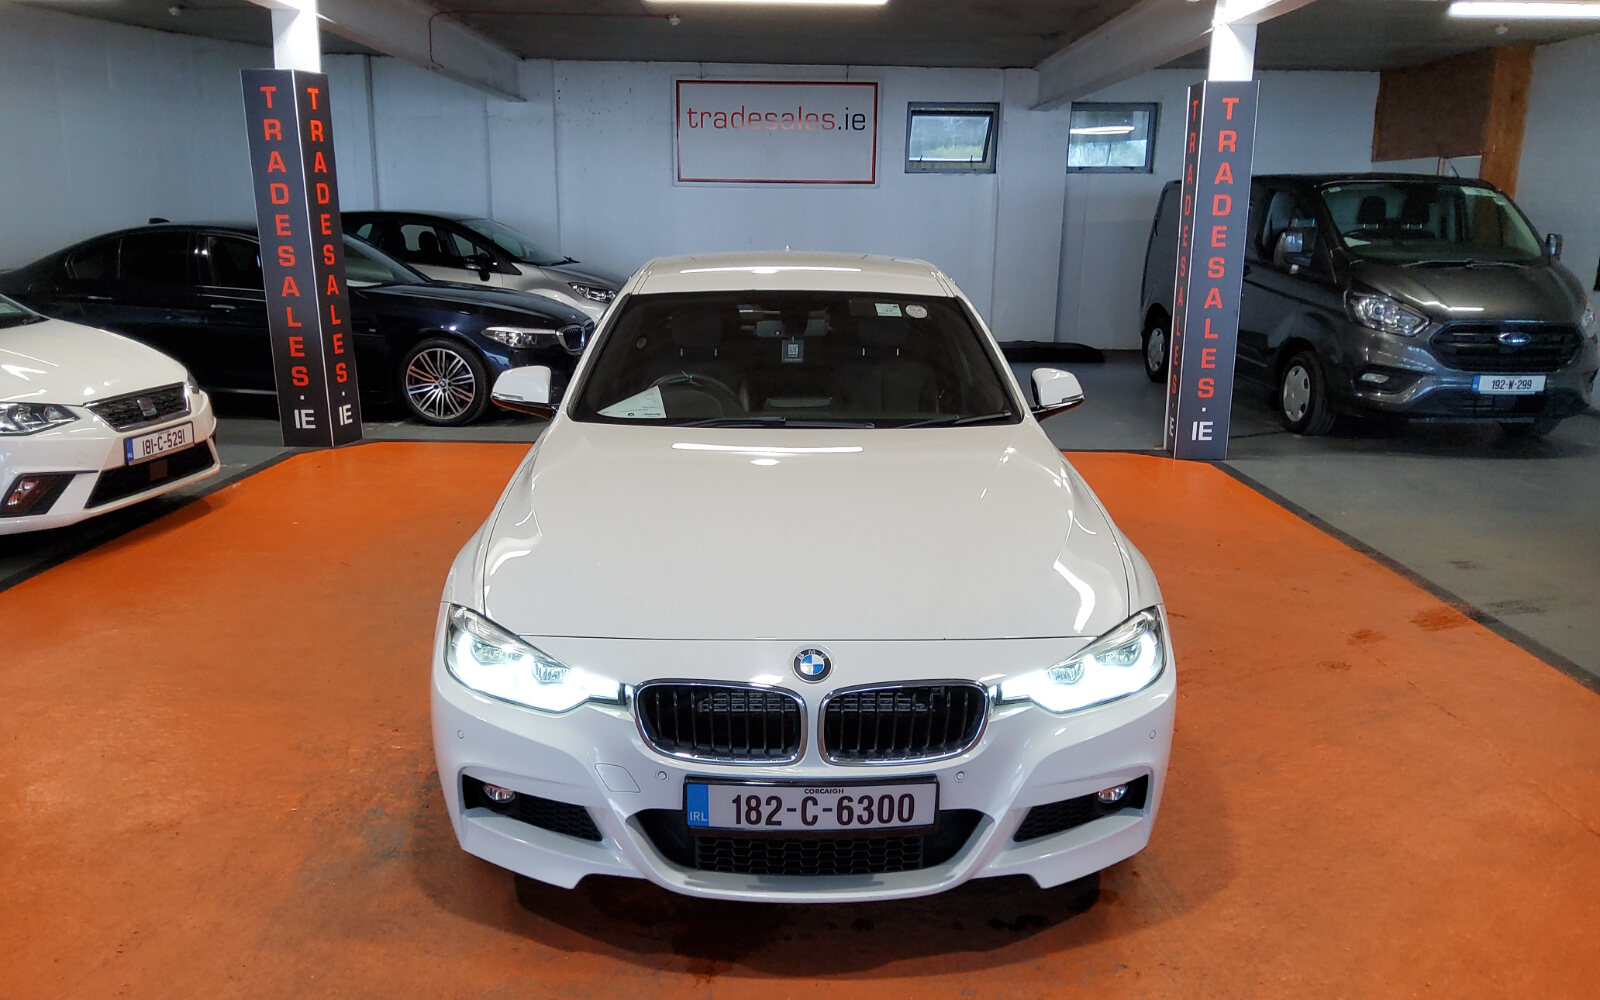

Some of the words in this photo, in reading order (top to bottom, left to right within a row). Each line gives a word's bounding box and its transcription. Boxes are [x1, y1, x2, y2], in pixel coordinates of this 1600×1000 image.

[686, 105, 866, 131] tradesales.ie
[1491, 379, 1533, 390] 192-W-299
[142, 429, 185, 456] 181-C-5291
[689, 811, 708, 822] IRL
[731, 793, 915, 827] 182-C-6300
